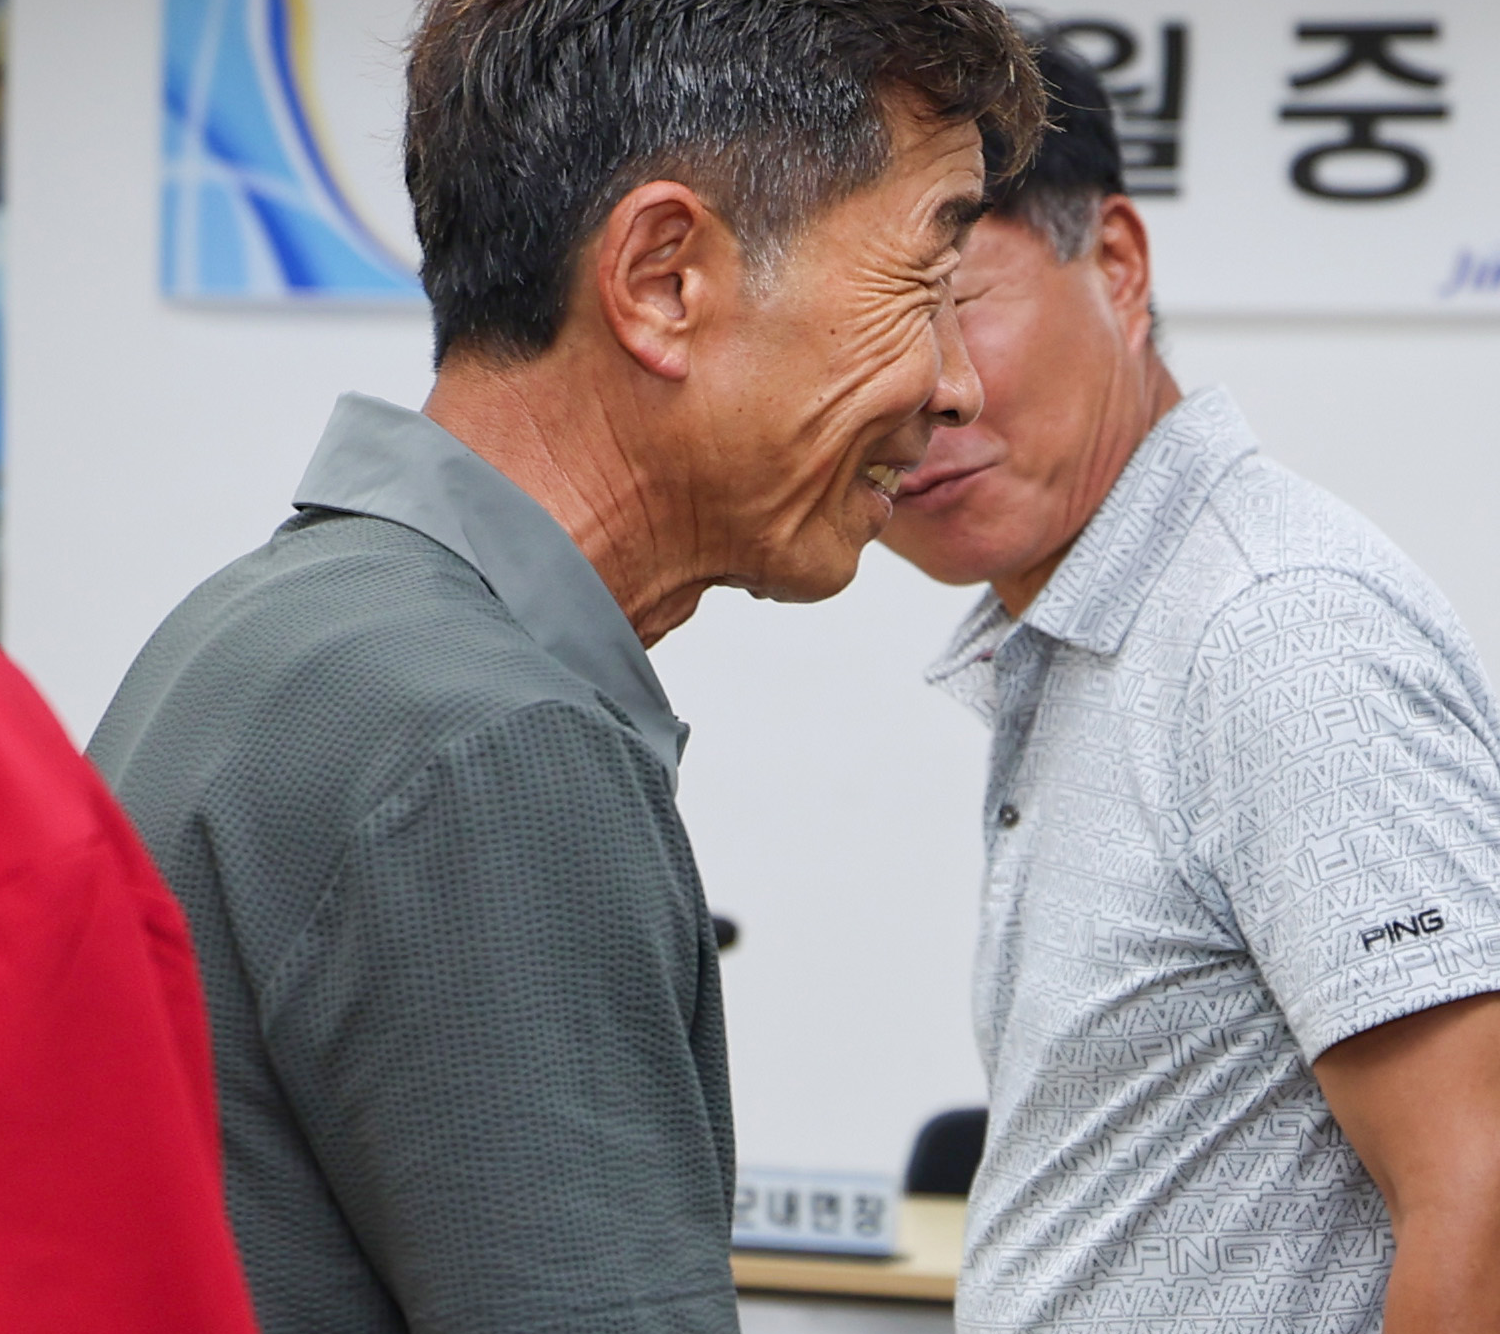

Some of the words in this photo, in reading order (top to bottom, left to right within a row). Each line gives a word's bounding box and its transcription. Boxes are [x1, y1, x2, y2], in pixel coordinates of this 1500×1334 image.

[1314, 693, 1446, 743] PING
[1260, 831, 1360, 904] PING
[1361, 908, 1445, 952] PING
[1131, 1028, 1268, 1068] PING
[1141, 1237, 1270, 1275] PING
